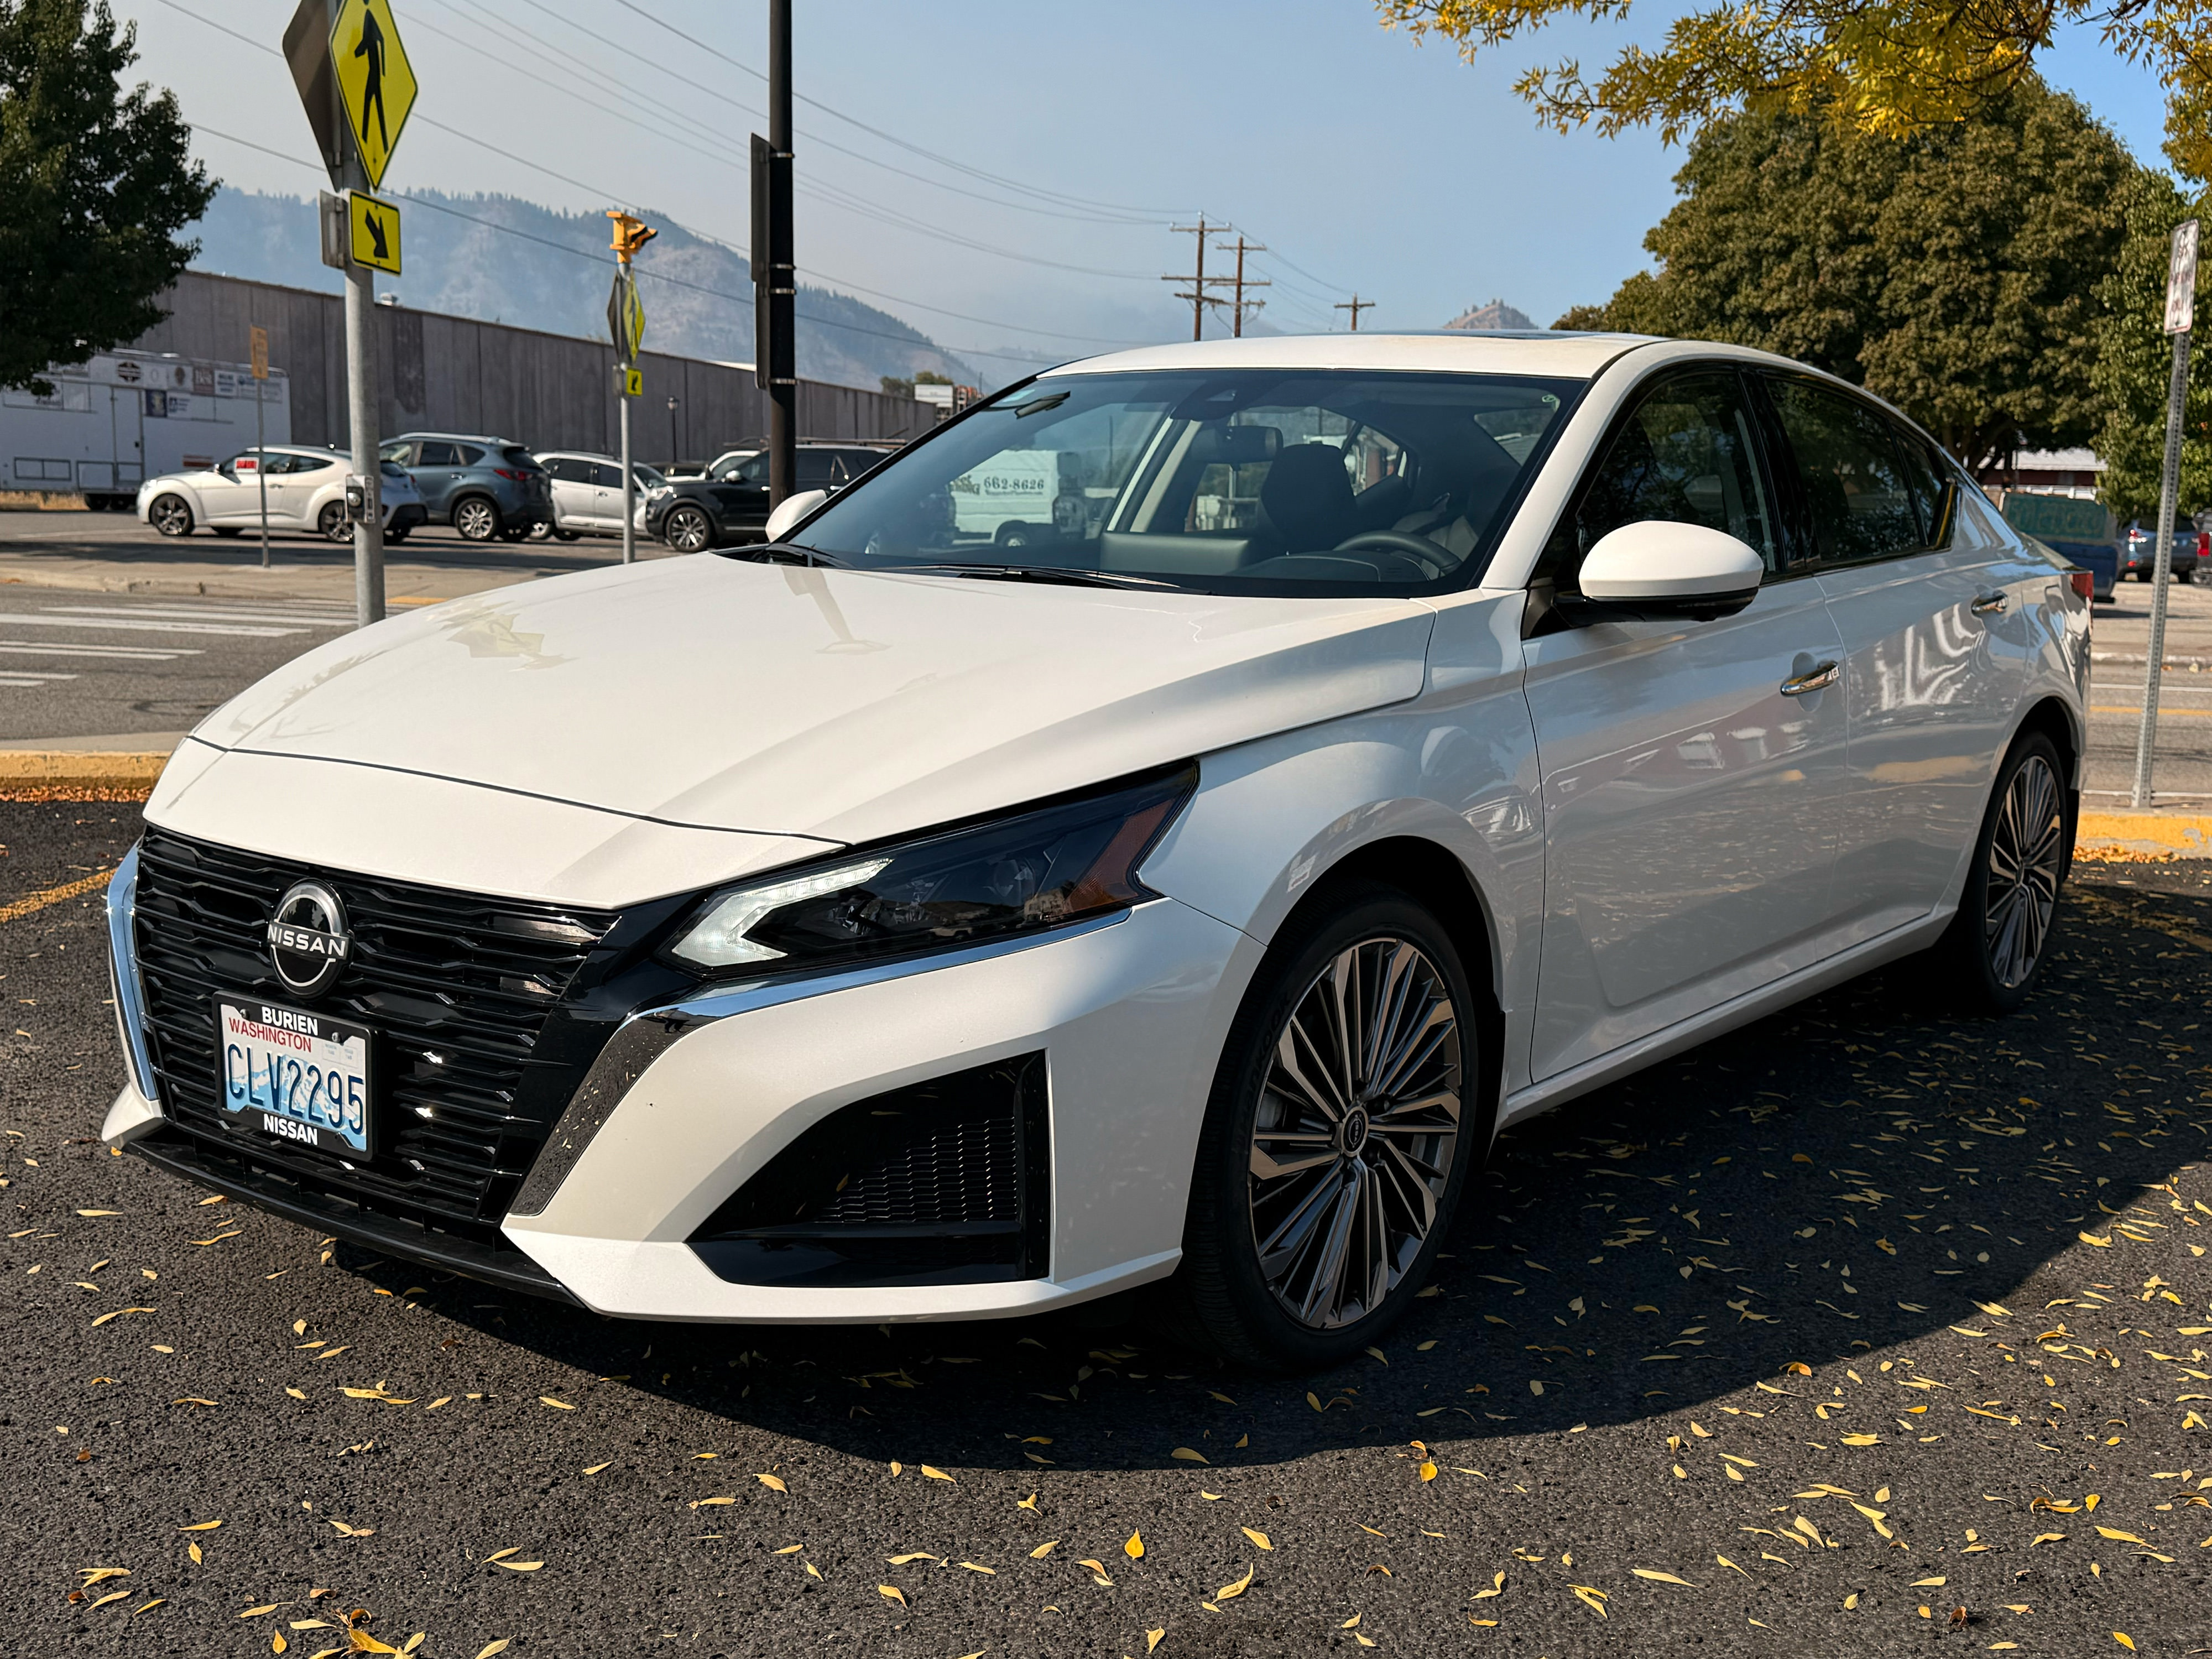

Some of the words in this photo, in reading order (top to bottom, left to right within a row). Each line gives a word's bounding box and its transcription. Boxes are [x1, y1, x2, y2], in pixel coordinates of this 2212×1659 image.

[268, 924, 346, 957] NISSAN
[229, 1018, 311, 1052] WASHINGTON
[262, 1006, 318, 1036] BURIEN
[228, 1044, 364, 1135] CLV2295
[264, 1113, 318, 1145] NISSAN
